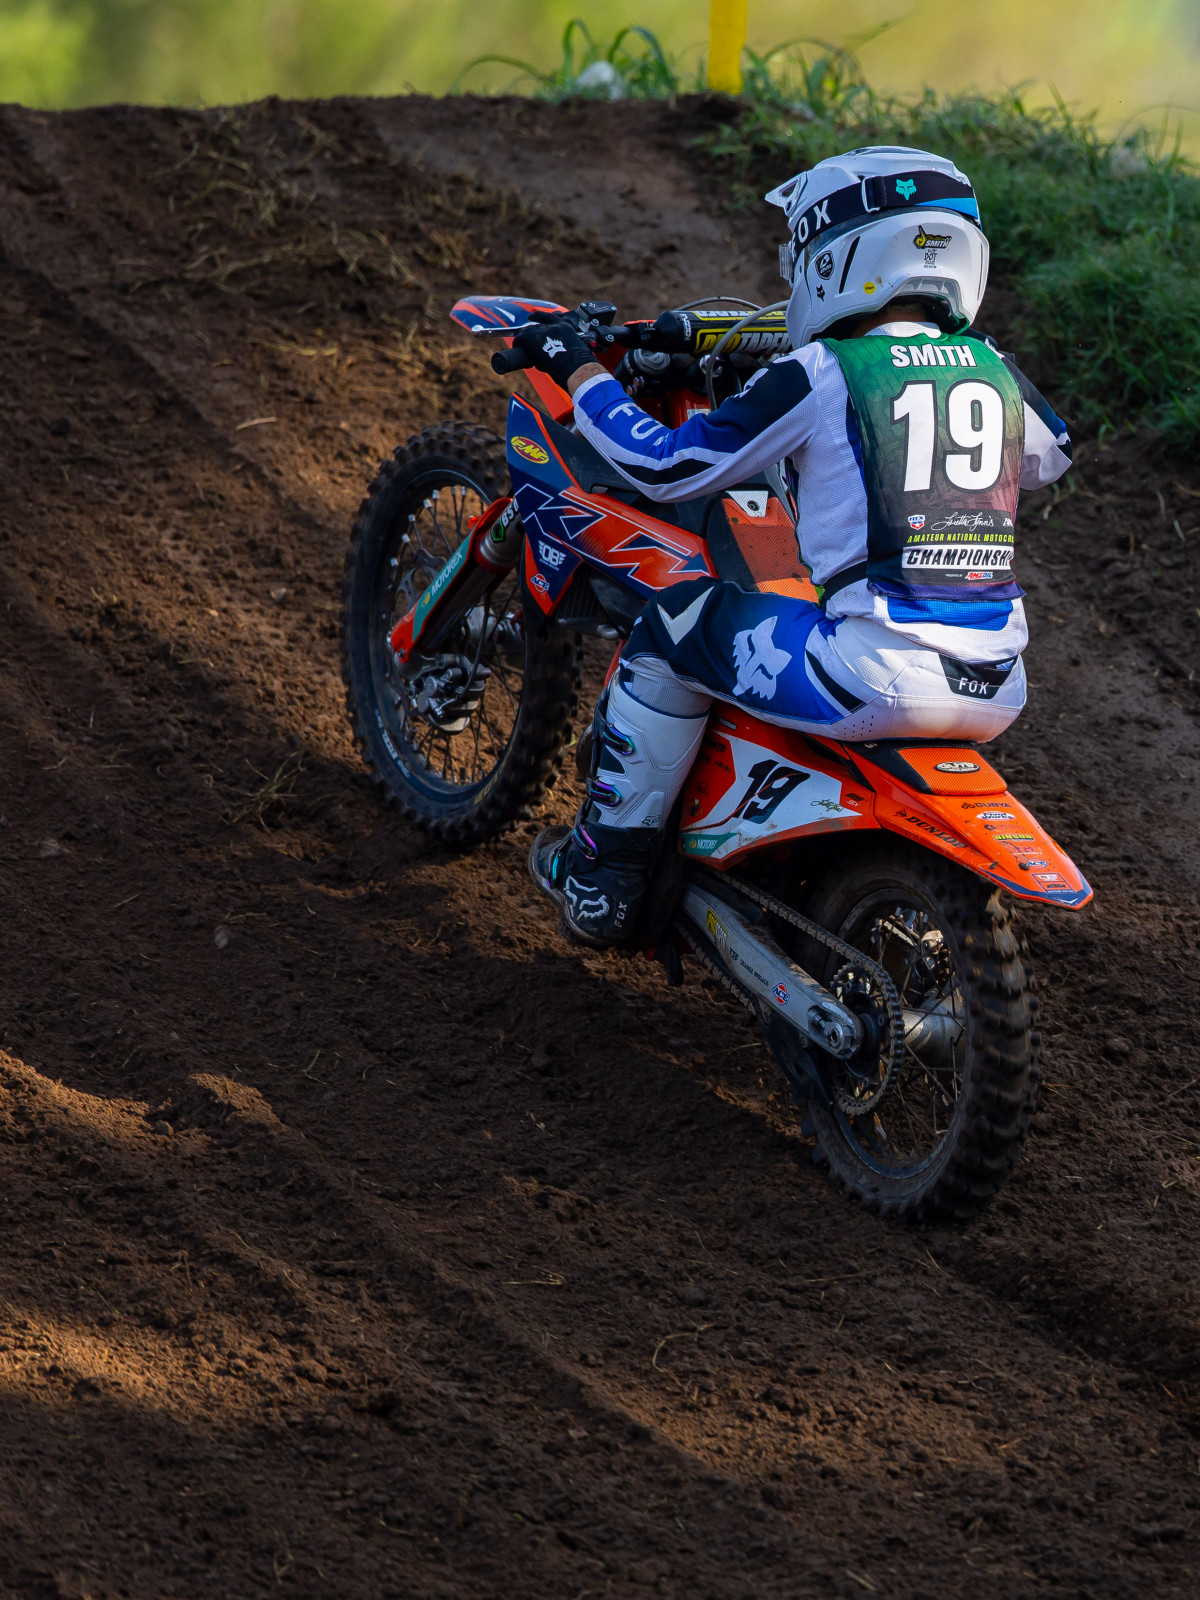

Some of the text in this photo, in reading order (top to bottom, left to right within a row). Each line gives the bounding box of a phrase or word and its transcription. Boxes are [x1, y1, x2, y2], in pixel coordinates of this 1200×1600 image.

[924, 252, 938, 261] DOT
[926, 240, 950, 248] SMITH
[890, 343, 977, 368] SMITH
[890, 378, 1006, 494] 19
[511, 436, 550, 464] FMF
[907, 533, 945, 543] AMATEUR
[947, 533, 981, 542] NATIONAL
[431, 550, 463, 597] MOTOREX
[531, 576, 550, 591] ACE
[967, 572, 993, 580] AMSOIL
[731, 759, 811, 825] 19
[905, 816, 970, 849] DUNLOP
[613, 901, 628, 928] FOX
[772, 987, 790, 1001] ACE
